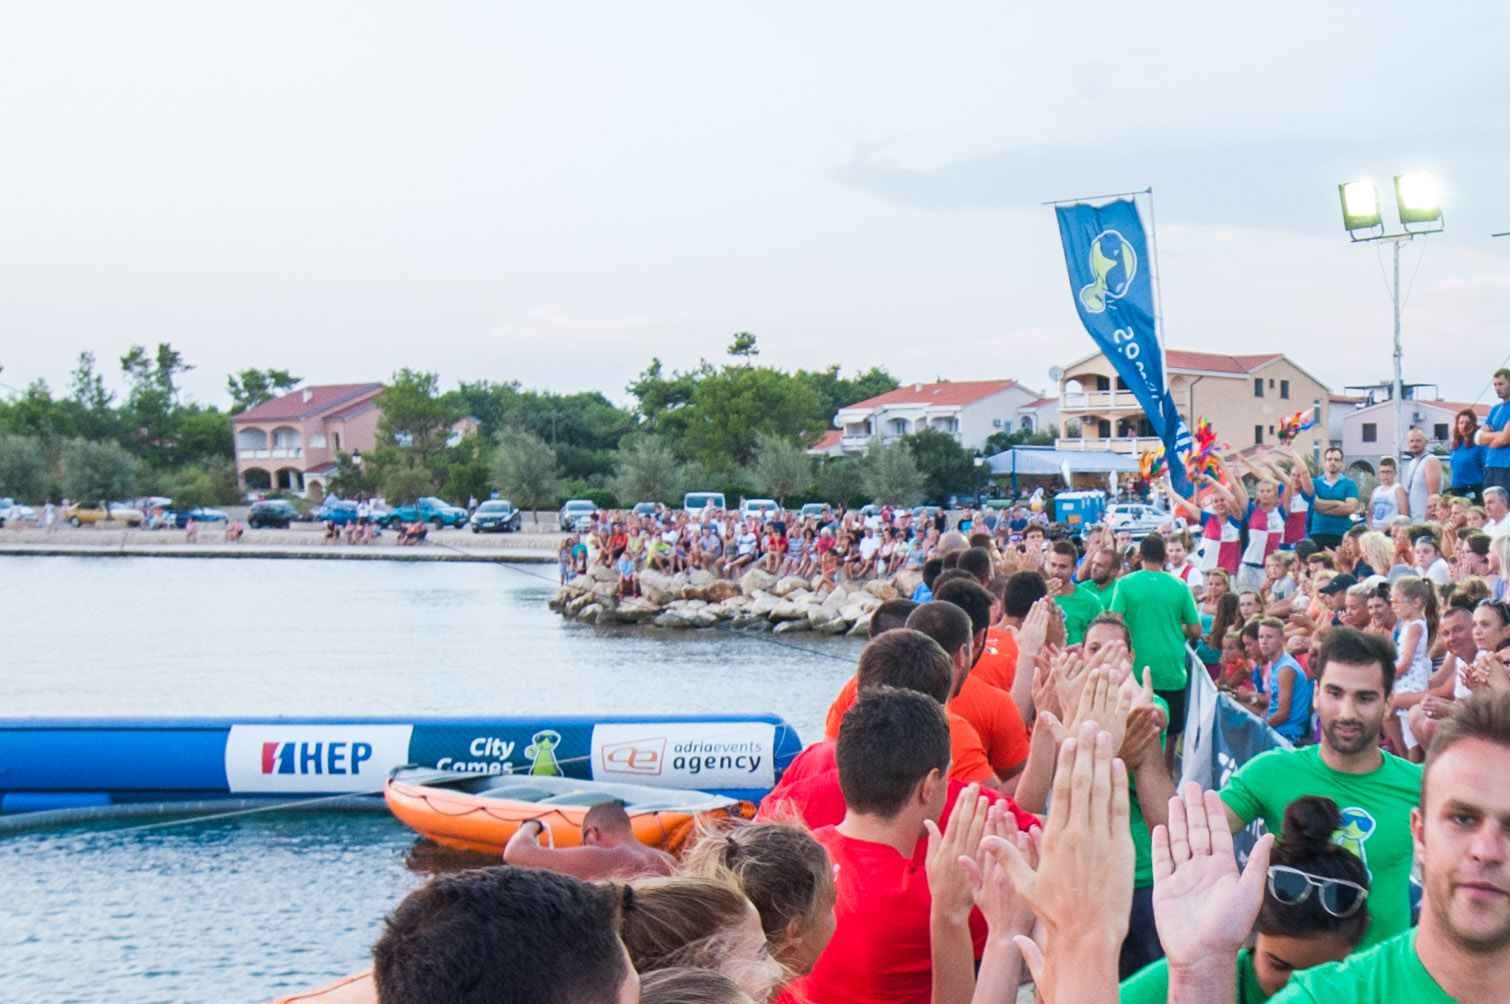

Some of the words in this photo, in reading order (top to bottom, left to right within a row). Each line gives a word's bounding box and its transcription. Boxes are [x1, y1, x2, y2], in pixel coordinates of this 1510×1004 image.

[469, 736, 516, 761] City
[674, 741, 763, 753] adriaevents
[300, 742, 373, 775] HEP
[673, 755, 762, 775] agency
